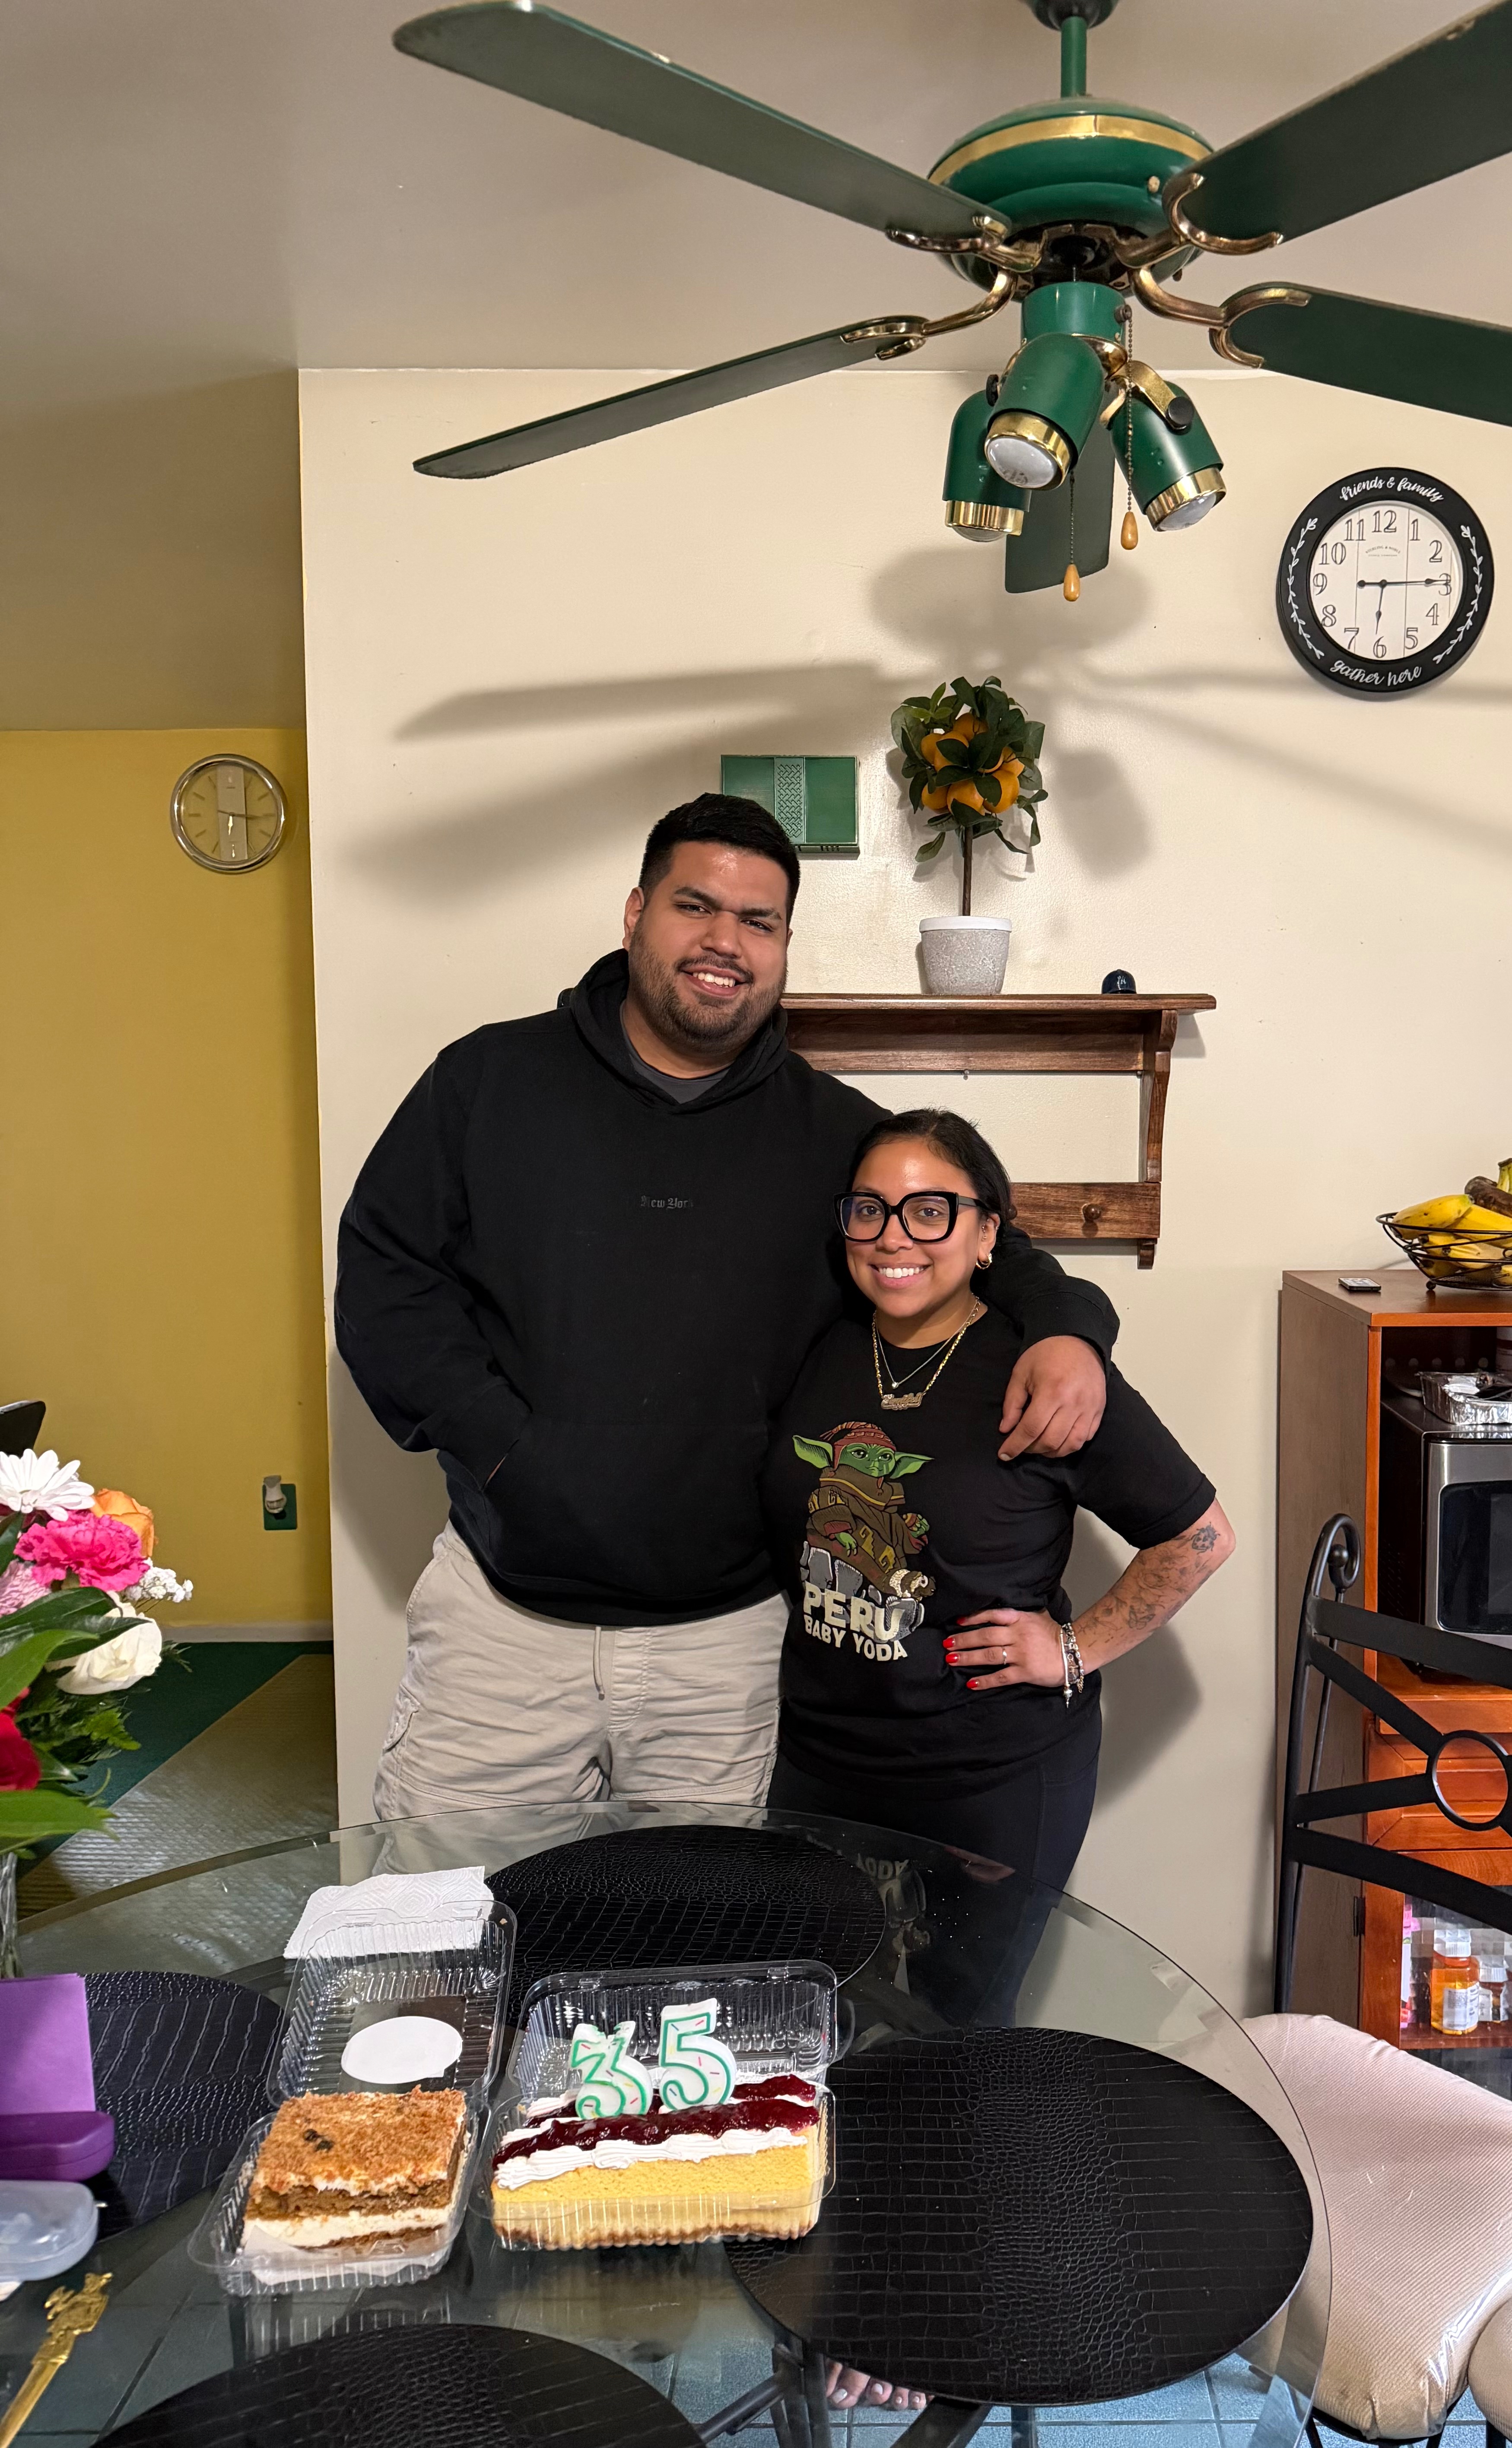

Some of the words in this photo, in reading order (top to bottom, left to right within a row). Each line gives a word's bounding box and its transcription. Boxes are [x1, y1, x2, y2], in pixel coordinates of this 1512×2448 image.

[1340, 476, 1385, 500] friends
[1387, 477, 1395, 488] &
[1397, 477, 1444, 502] family
[1344, 518, 1366, 541] 11
[1372, 510, 1397, 533] 12
[1410, 518, 1420, 541] 1
[1318, 542, 1346, 565] 10
[1429, 540, 1442, 562] 2
[1313, 573, 1328, 596] 9
[1439, 573, 1452, 596] 3
[1321, 604, 1337, 627] 8
[1426, 603, 1440, 625] 4
[1344, 628, 1360, 650] 7
[1373, 636, 1387, 658] 6
[1405, 627, 1418, 649] 5
[1330, 660, 1385, 685] gather
[1388, 666, 1422, 686] here
[804, 1580, 905, 1641] PERU
[804, 1614, 846, 1648] BABY
[852, 1632, 908, 1661] YODA
